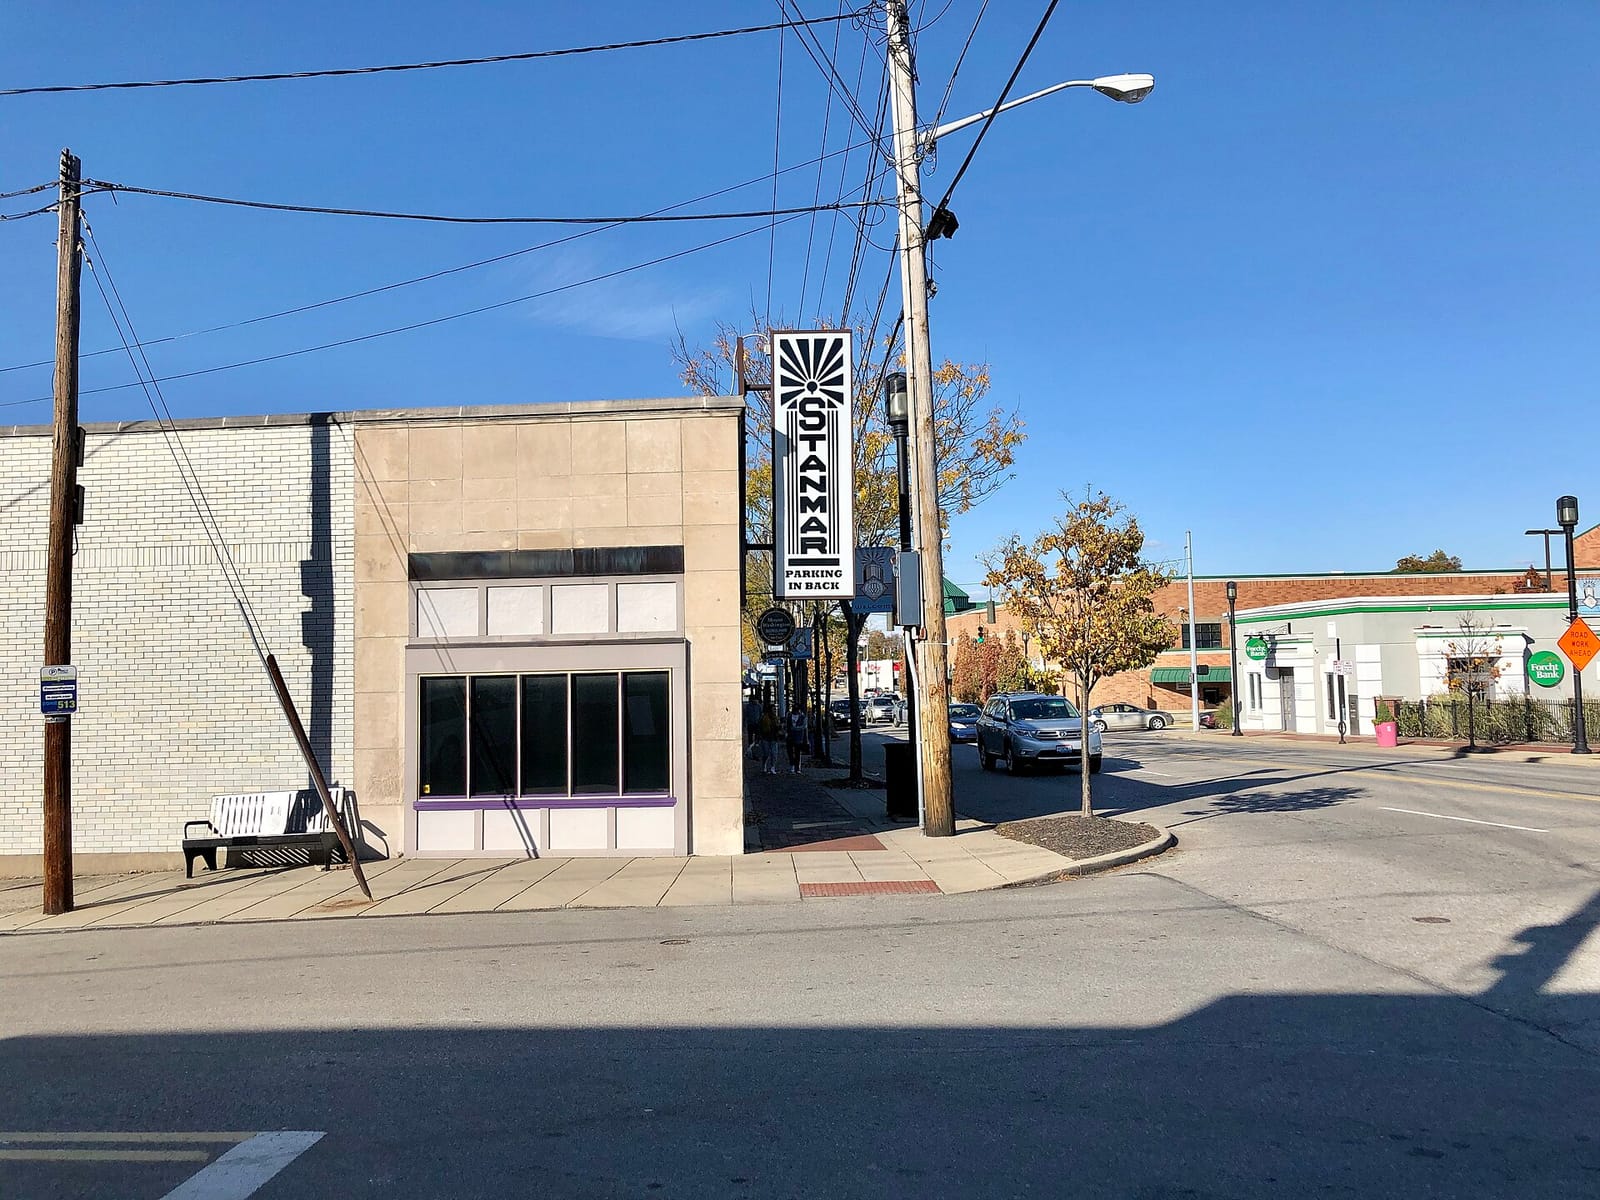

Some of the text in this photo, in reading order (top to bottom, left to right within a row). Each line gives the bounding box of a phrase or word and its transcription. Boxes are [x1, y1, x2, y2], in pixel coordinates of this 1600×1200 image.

[798, 397, 828, 555] STANMAR
[785, 569, 843, 578] PARKING
[788, 582, 840, 590] IN BACK
[1569, 649, 1592, 657] AHEAD
[1531, 662, 1559, 672] Forcht
[1536, 670, 1560, 679] Bank
[58, 700, 75, 709] 513
